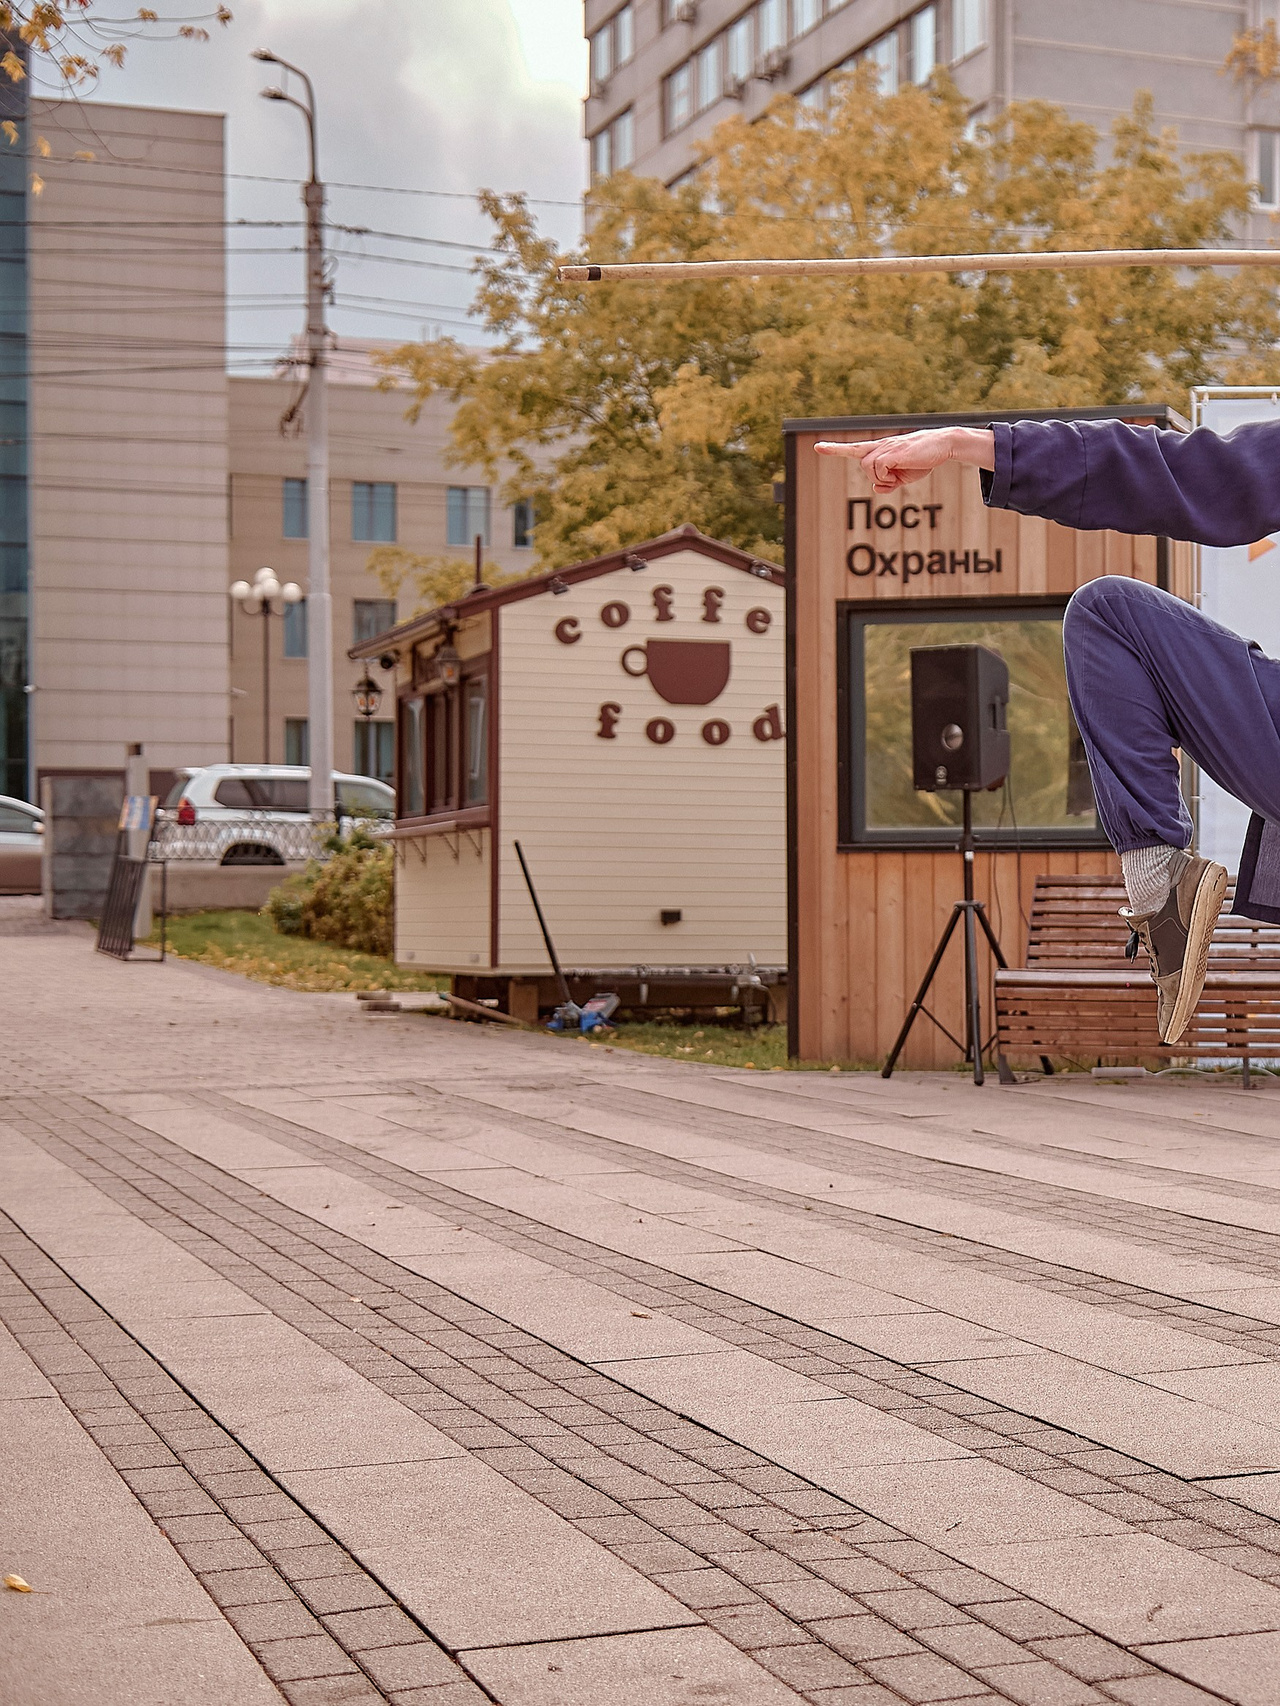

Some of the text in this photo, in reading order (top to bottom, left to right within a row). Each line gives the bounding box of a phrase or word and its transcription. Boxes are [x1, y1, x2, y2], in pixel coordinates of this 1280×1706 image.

[847, 497, 943, 530] Пост
[847, 543, 1003, 583] Охраны
[596, 701, 786, 745] food
